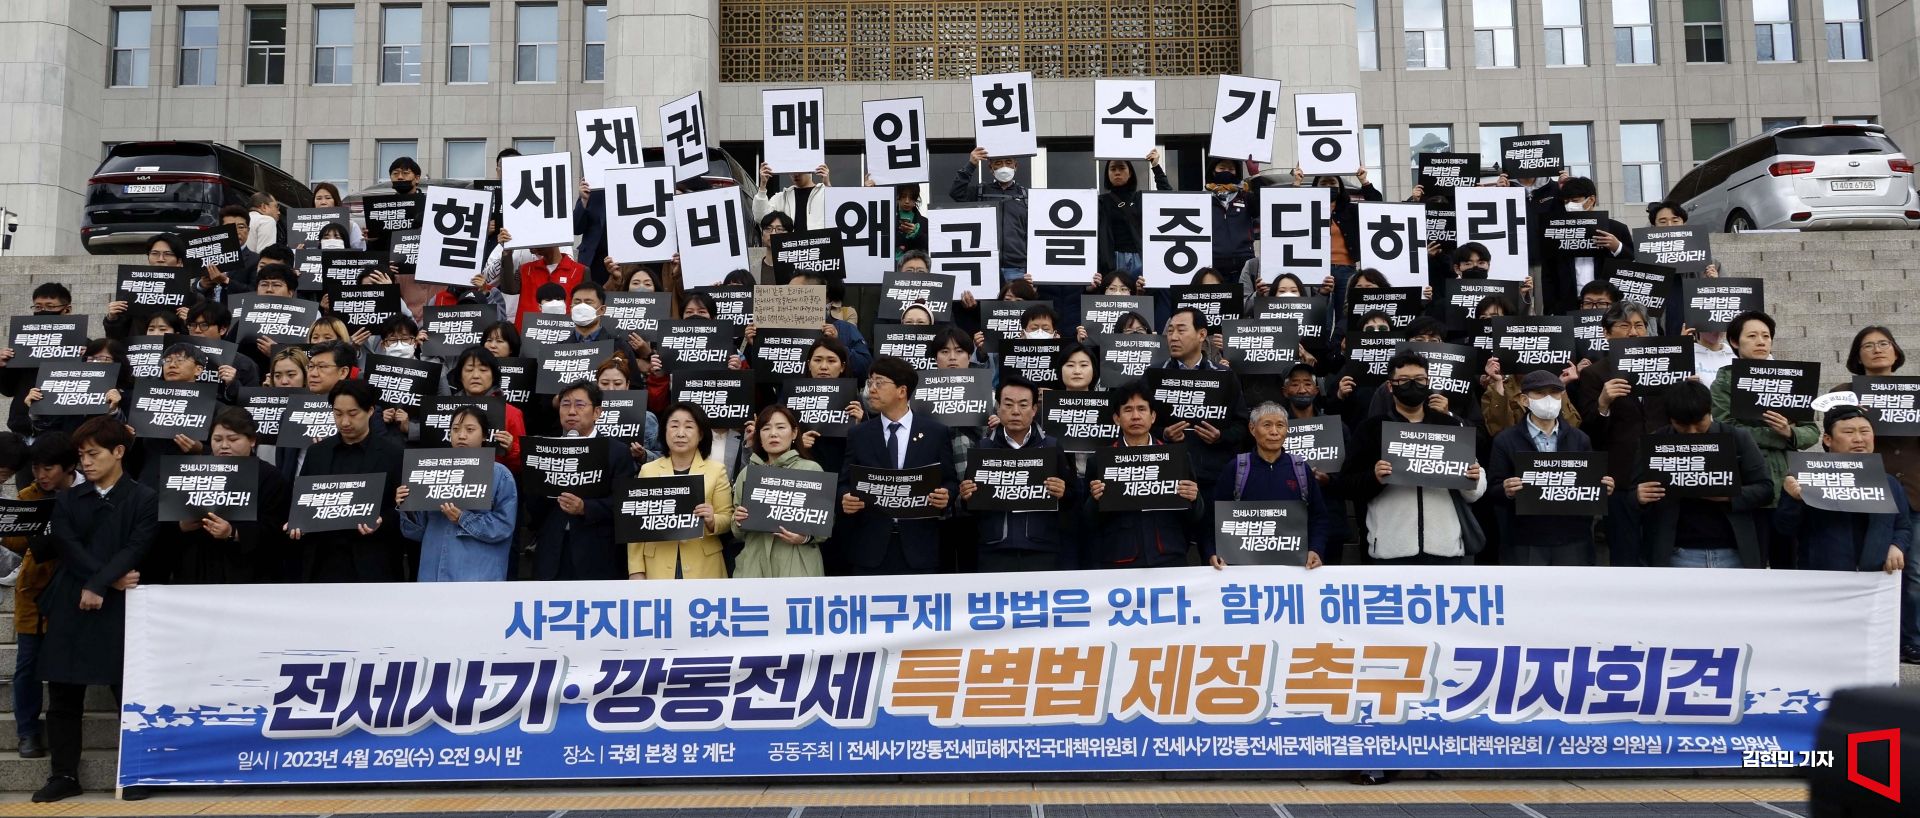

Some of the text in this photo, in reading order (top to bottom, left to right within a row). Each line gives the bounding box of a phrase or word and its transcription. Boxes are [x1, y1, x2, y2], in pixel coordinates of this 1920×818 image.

[982, 83, 1029, 133] 회
[1101, 91, 1154, 138] 수
[1222, 89, 1276, 140] 가
[772, 100, 819, 150] 매
[586, 117, 639, 164] 채
[667, 104, 703, 167] 권
[872, 109, 921, 170] 입
[1299, 107, 1352, 162] 능
[1505, 148, 1543, 159] 특별법을
[1519, 158, 1560, 169] 제정하라!
[1422, 167, 1460, 176] 특별법을
[1434, 177, 1475, 186] 제정하라!
[511, 164, 567, 219] 세
[616, 179, 674, 248] 낭
[432, 198, 484, 270] 혈
[687, 199, 741, 257] 비
[835, 199, 891, 258] 왜
[1034, 199, 1096, 266] 을
[1271, 200, 1330, 267] 단
[1467, 199, 1526, 256] 라
[1150, 208, 1211, 274] 중
[1367, 214, 1426, 274] 하
[1639, 240, 1685, 253] 특별법을
[931, 222, 991, 286] 곡
[1656, 251, 1705, 264] 제정하라!
[121, 280, 166, 292] 특별법을
[135, 293, 184, 305] 제정하라!
[245, 312, 291, 324] 특별법을
[257, 324, 309, 337] 제정하라!
[15, 334, 62, 345] 특별법을
[661, 336, 707, 349] 특별법을
[1228, 336, 1274, 348] 특별법을
[1500, 337, 1550, 349] 특별법을
[29, 346, 81, 358] 제정하라!
[677, 350, 727, 362] 제정하라!
[1244, 350, 1293, 361] 제정하라!
[1516, 351, 1570, 364] 제정하라!
[40, 381, 90, 392] 특별법을
[1737, 378, 1793, 393] 특별법을
[54, 393, 106, 405] 제정하라!
[915, 387, 965, 401] 특별법을
[1154, 389, 1205, 404] 특별법을
[1755, 393, 1811, 409] 제정하라!
[136, 398, 188, 413] 특별법을
[787, 397, 829, 409] 특별법을
[932, 400, 986, 414] 제정하라!
[799, 410, 849, 424] 제정하라!
[1048, 409, 1098, 423] 특별법을
[1170, 406, 1227, 419] 제정하라!
[150, 413, 206, 428] 제정하라!
[1065, 425, 1120, 437] 제정하라!
[1387, 442, 1445, 459] 특별법을
[526, 455, 579, 471] 특별법을
[1406, 459, 1469, 476] 제정하라!
[1649, 457, 1705, 471] 특별법을
[409, 470, 464, 484] 특별법을
[544, 470, 602, 486] 제정하라!
[974, 471, 1029, 485] 특별법을
[1104, 466, 1160, 480] 특별법을
[1522, 472, 1577, 485] 특별법을
[1670, 472, 1732, 486] 제정하라!
[1797, 472, 1855, 487] 특별법을
[166, 475, 227, 490] 특별법을
[856, 482, 911, 496] 특별법을
[186, 491, 250, 507] 제정하라!
[297, 492, 353, 506] 특별법을
[426, 485, 487, 498] 제정하라!
[750, 488, 806, 506] 특별법을
[1540, 487, 1600, 501] 제정하라!
[1822, 487, 1884, 501] 제정하라!
[313, 504, 374, 519] 제정하라!
[621, 500, 676, 516] 특별법을
[767, 505, 828, 525] 제정하라!
[640, 514, 700, 531] 제정하라!
[1221, 521, 1276, 535] 특별법을
[1240, 537, 1301, 551] 제정하라!
[505, 583, 1505, 640] 사각지대 없는 피해구제 방법은 있다. 함께 해결하자!
[890, 645, 1106, 719] 특별법
[1122, 643, 1266, 717] 제정
[1283, 642, 1430, 716] 촉구
[1446, 643, 1741, 717] 기자회견
[563, 742, 735, 765] 장소 국회 본청 앞 계단
[768, 741, 833, 761] 공동주최
[847, 737, 1137, 760] 전세사기깡통전세피해자전국대책위원회
[1153, 735, 1543, 757] 전세사기깡통전세문제해결을위한시민사회대책위원회
[1559, 735, 1608, 755] 심상정
[1613, 735, 1661, 755] 의원실
[1677, 735, 1727, 754] 조오섭
[238, 745, 522, 770] 일시 2023년 4월 26일(수) 오전 9시 반
